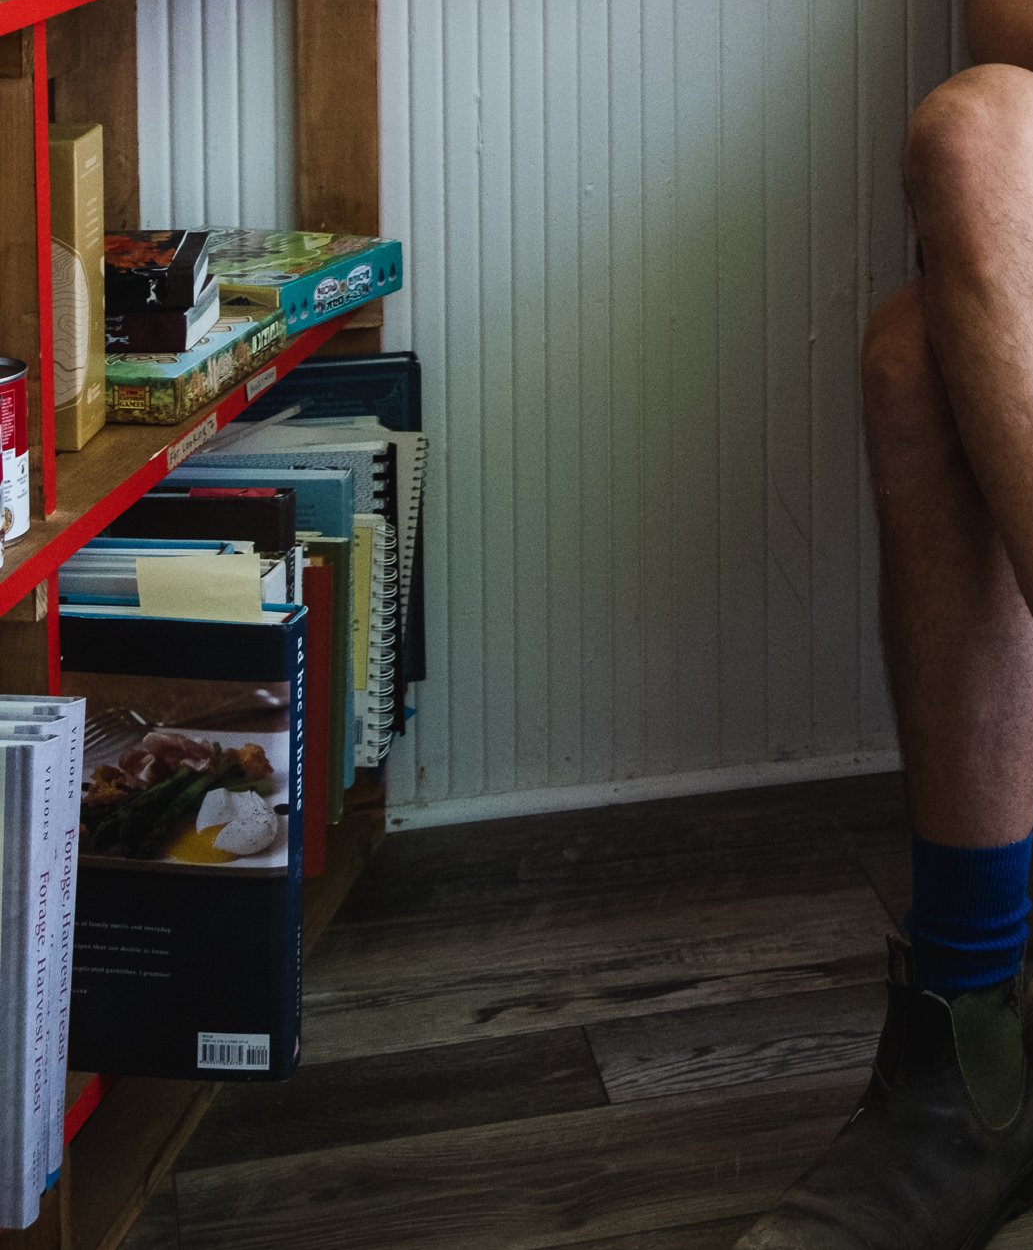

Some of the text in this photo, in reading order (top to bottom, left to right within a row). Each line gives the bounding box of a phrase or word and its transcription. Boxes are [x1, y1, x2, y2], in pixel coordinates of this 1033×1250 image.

[295, 636, 304, 812] ad hoc at home
[32, 765, 51, 1113] VILJOEN Forage, Harvest, Feast
[57, 726, 77, 1064] VILJOEN Forage, Harvest, Feast
